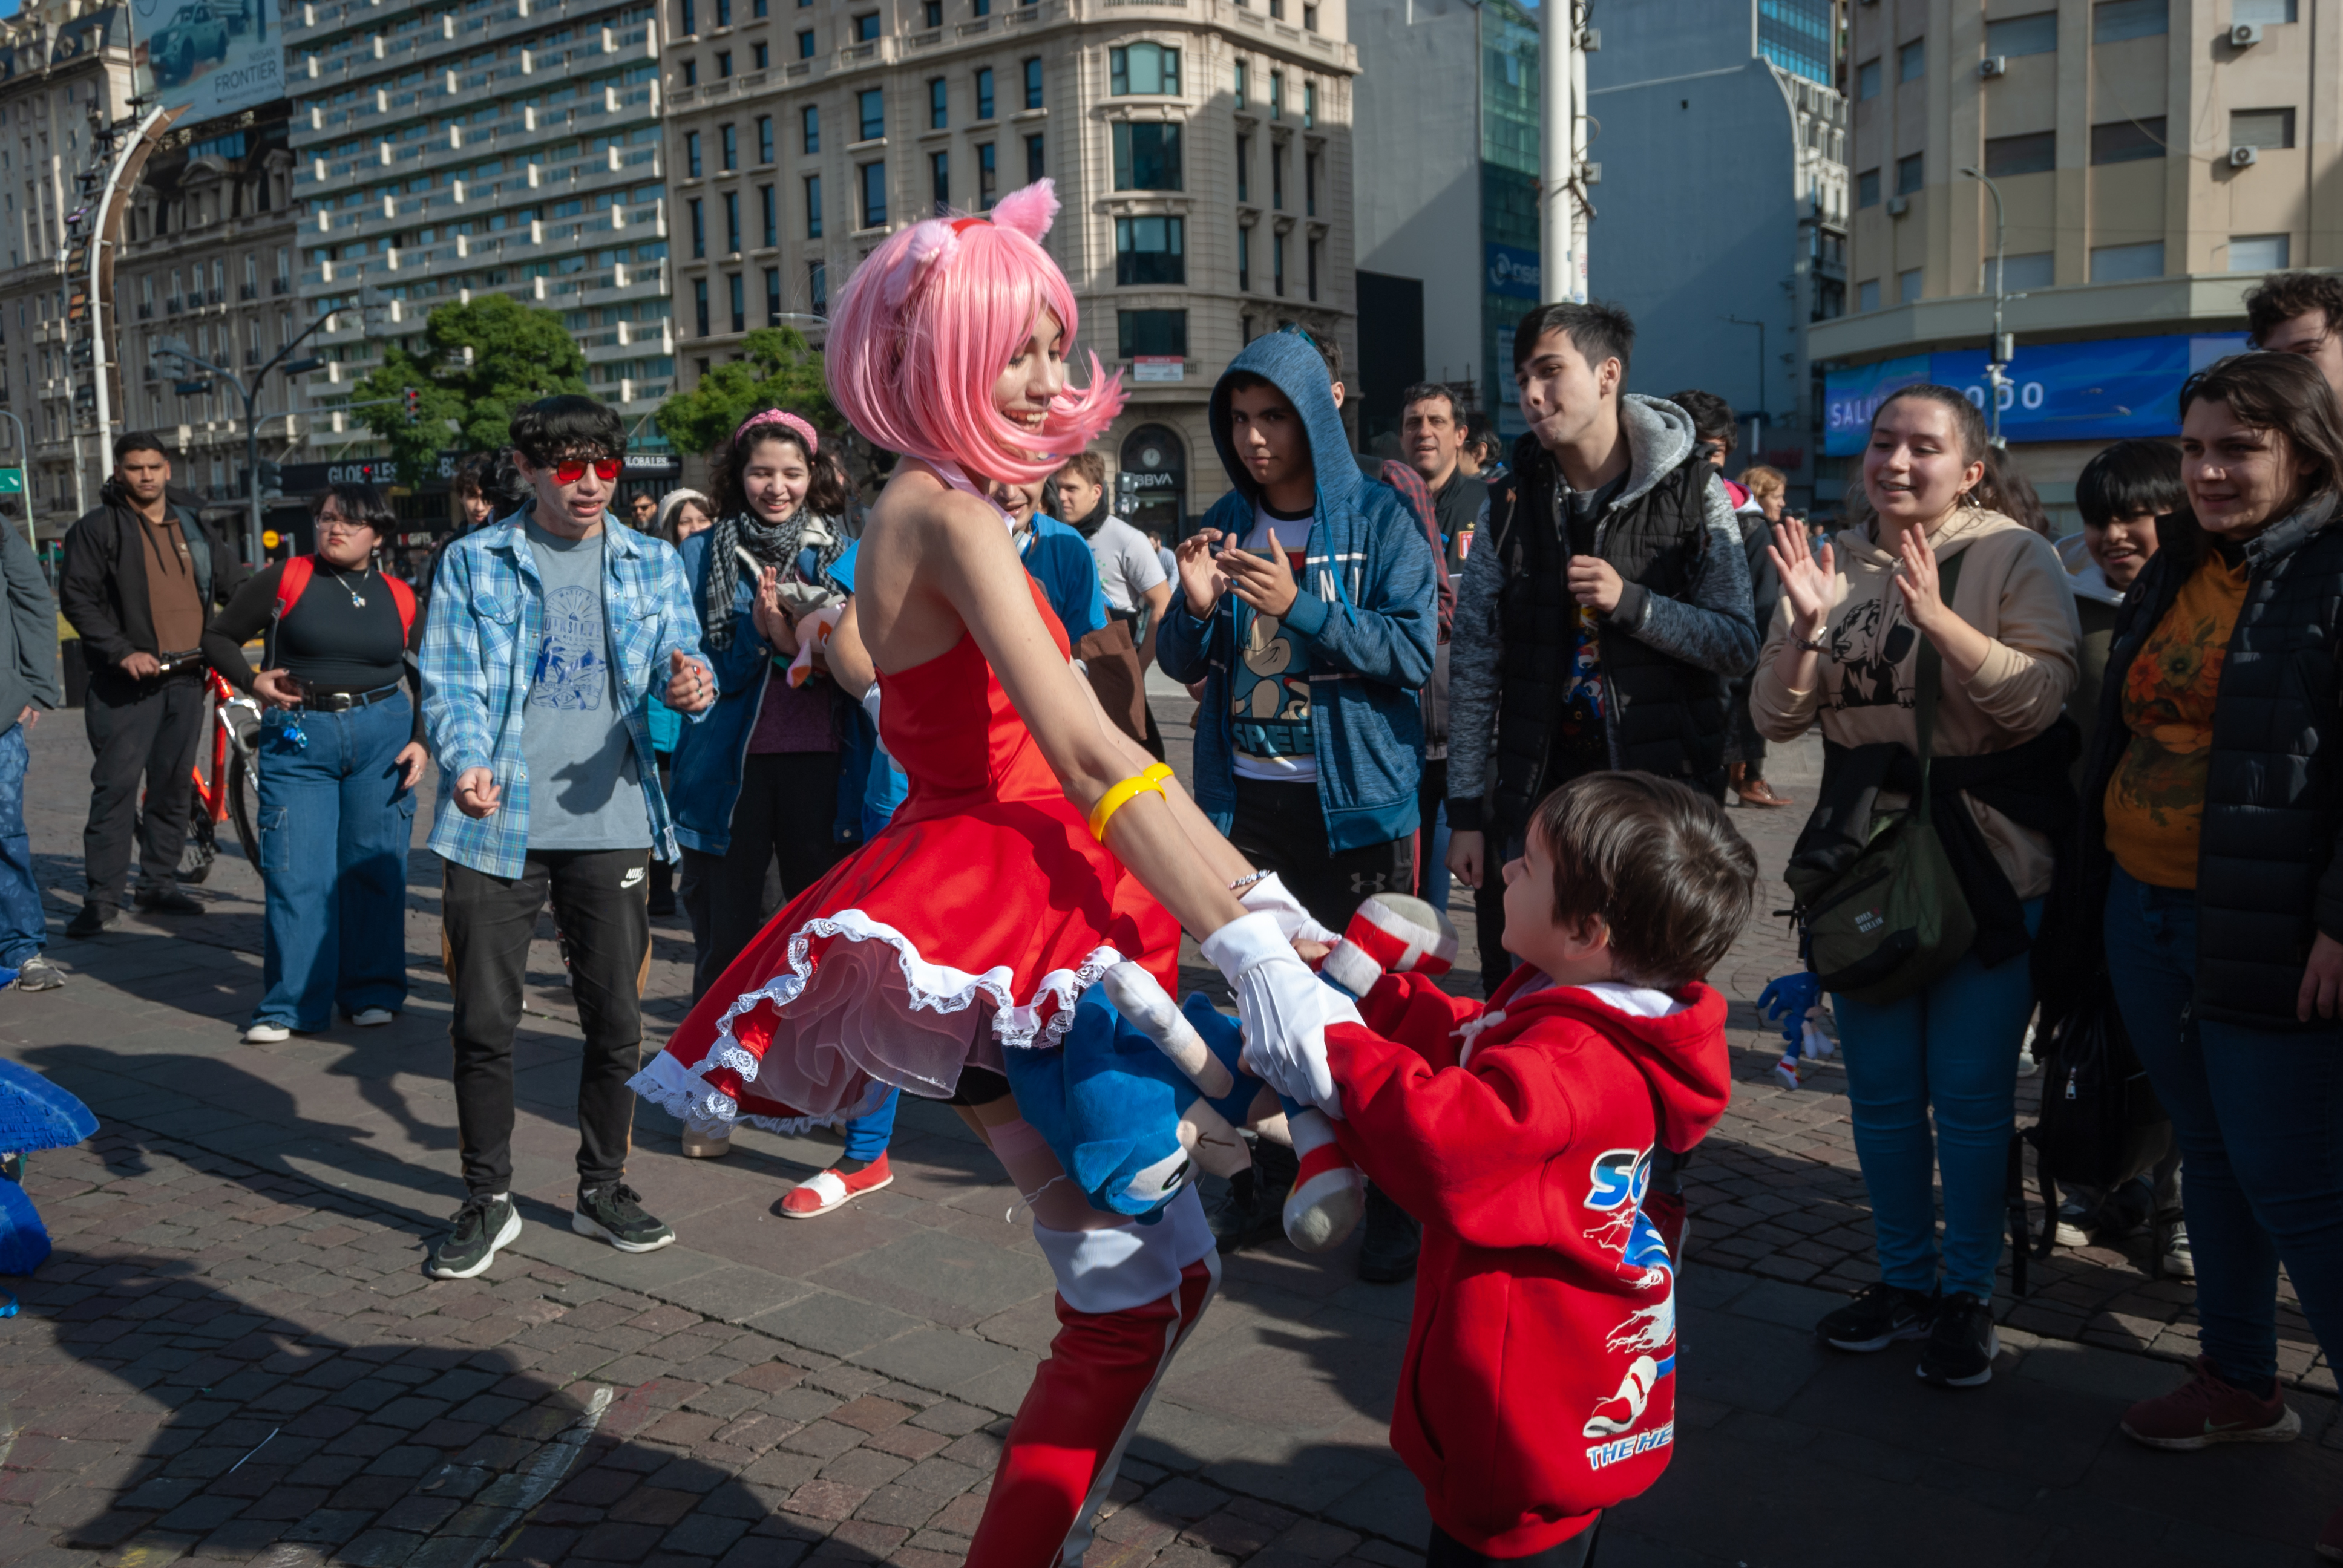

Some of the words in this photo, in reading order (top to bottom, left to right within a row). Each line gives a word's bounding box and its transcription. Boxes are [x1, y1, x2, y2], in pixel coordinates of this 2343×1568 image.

[215, 60, 277, 94] FRONTIER
[1830, 396, 1883, 428] SALU
[1136, 472, 1173, 487] BBVA
[545, 617, 602, 638] UIKSILVE
[626, 867, 644, 879] NIKE
[1586, 1434, 1638, 1471] THE
[1635, 1420, 1674, 1454] HE
